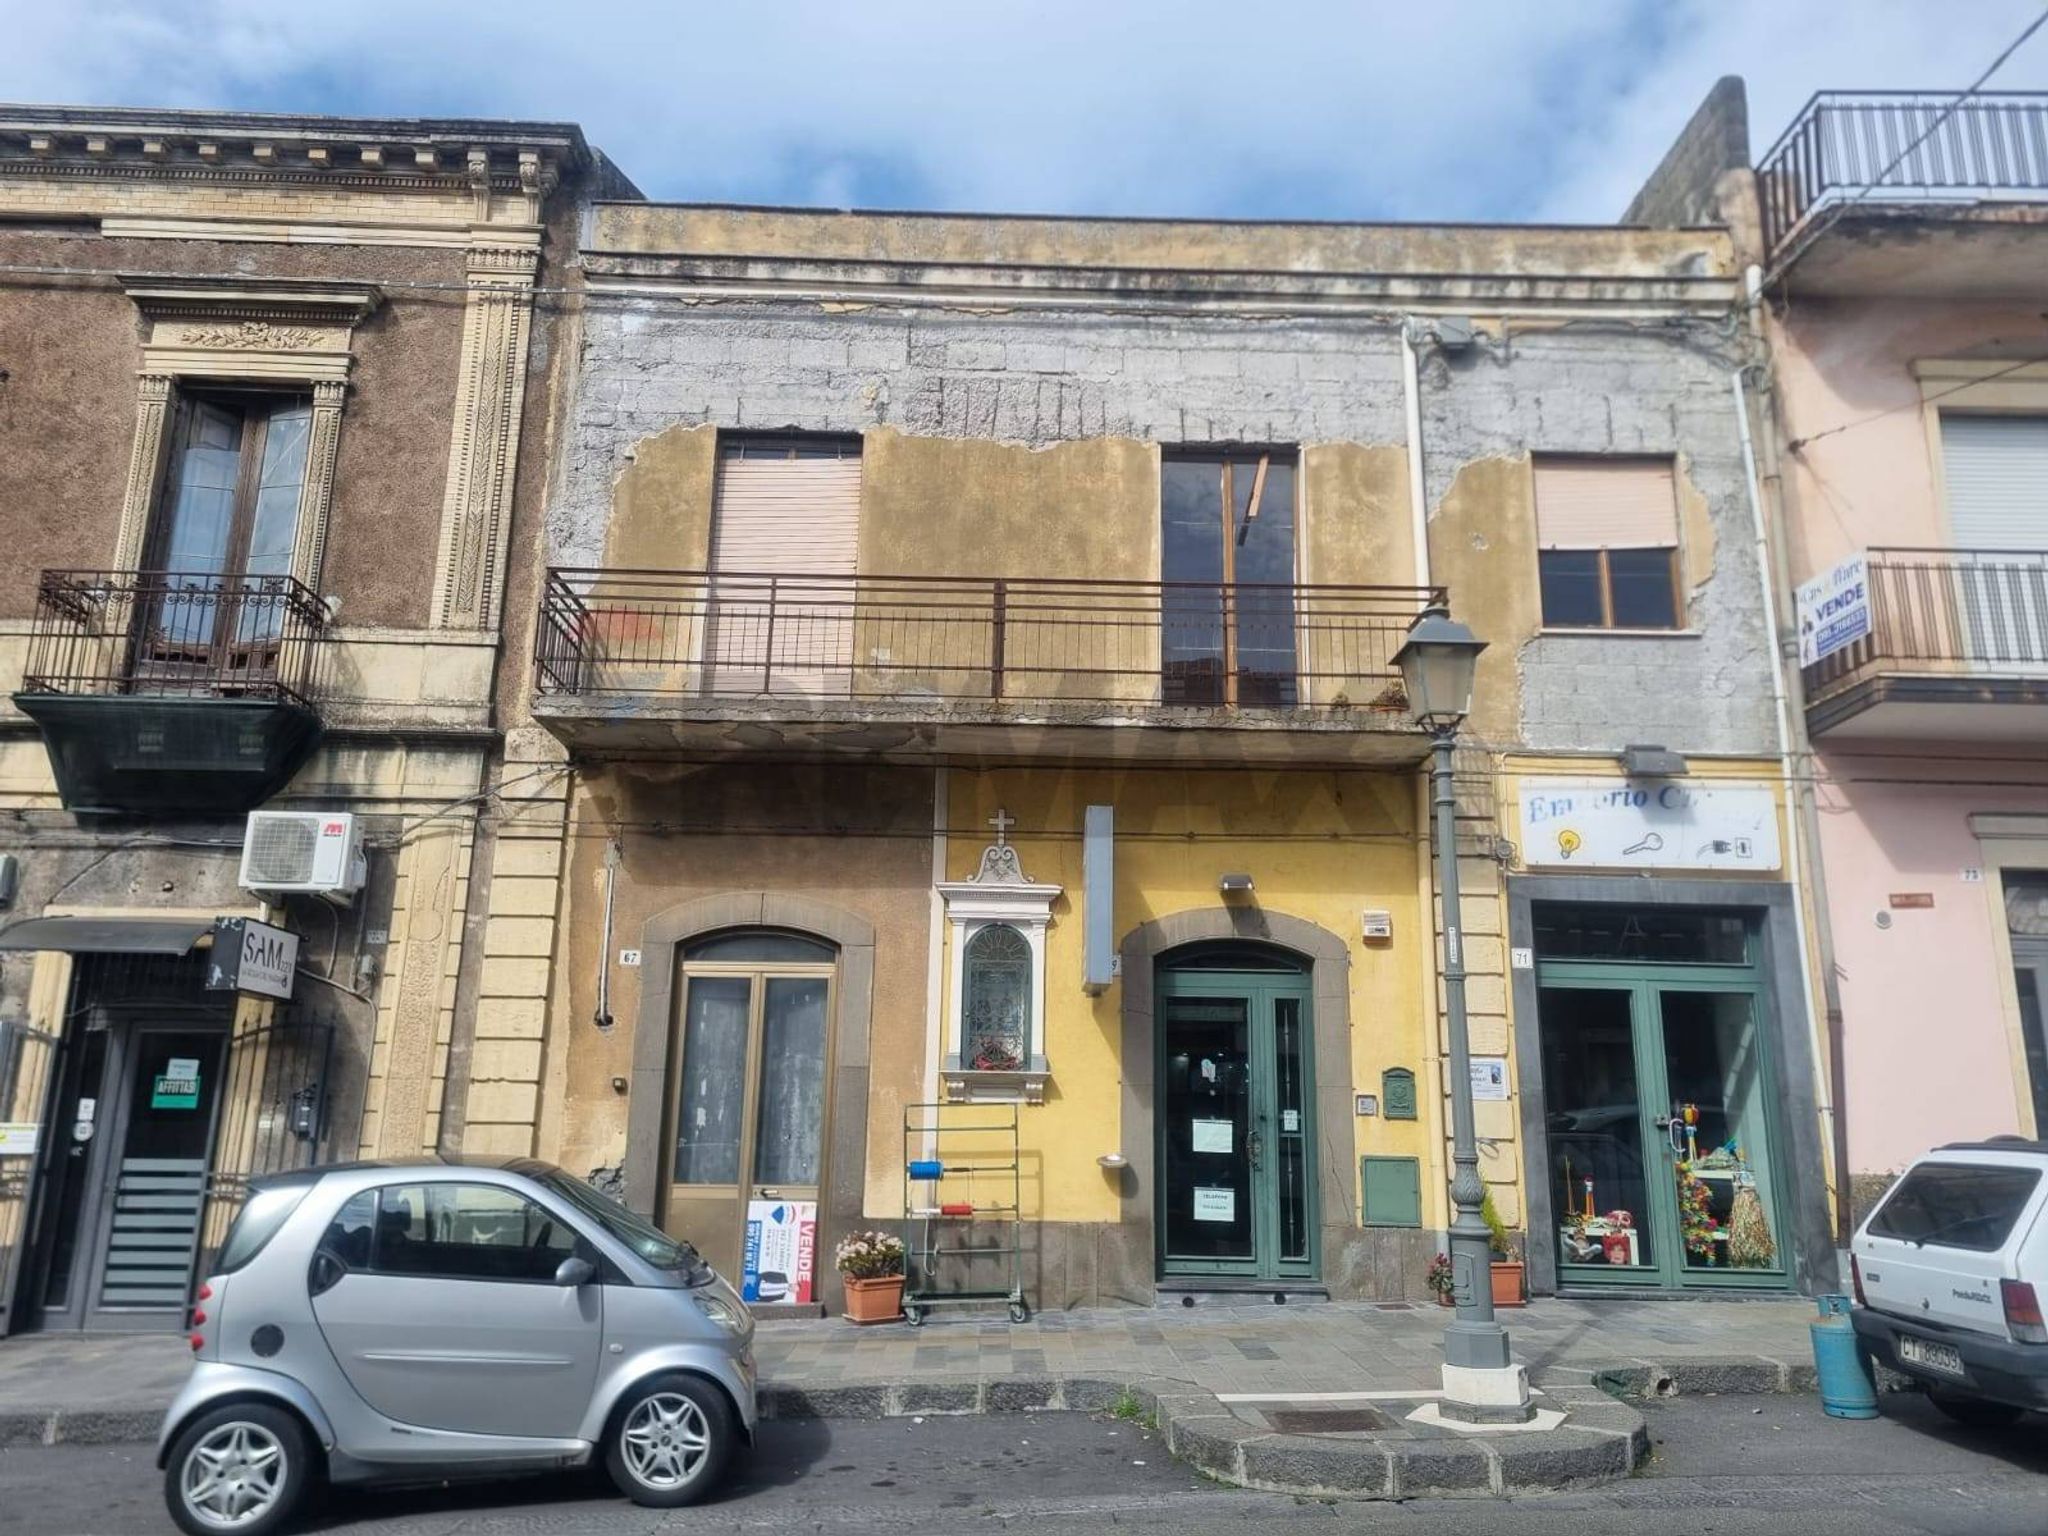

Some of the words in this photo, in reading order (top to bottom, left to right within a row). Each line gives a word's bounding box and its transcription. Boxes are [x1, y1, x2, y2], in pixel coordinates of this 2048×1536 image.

[1816, 582, 1865, 620] VENDE
[1528, 779, 1648, 824] Emrio
[244, 932, 284, 970] SAM
[624, 952, 637, 963] 67
[1516, 952, 1527, 965] 71
[798, 1222, 816, 1282] VENDE
[1903, 1337, 1918, 1358] CT
